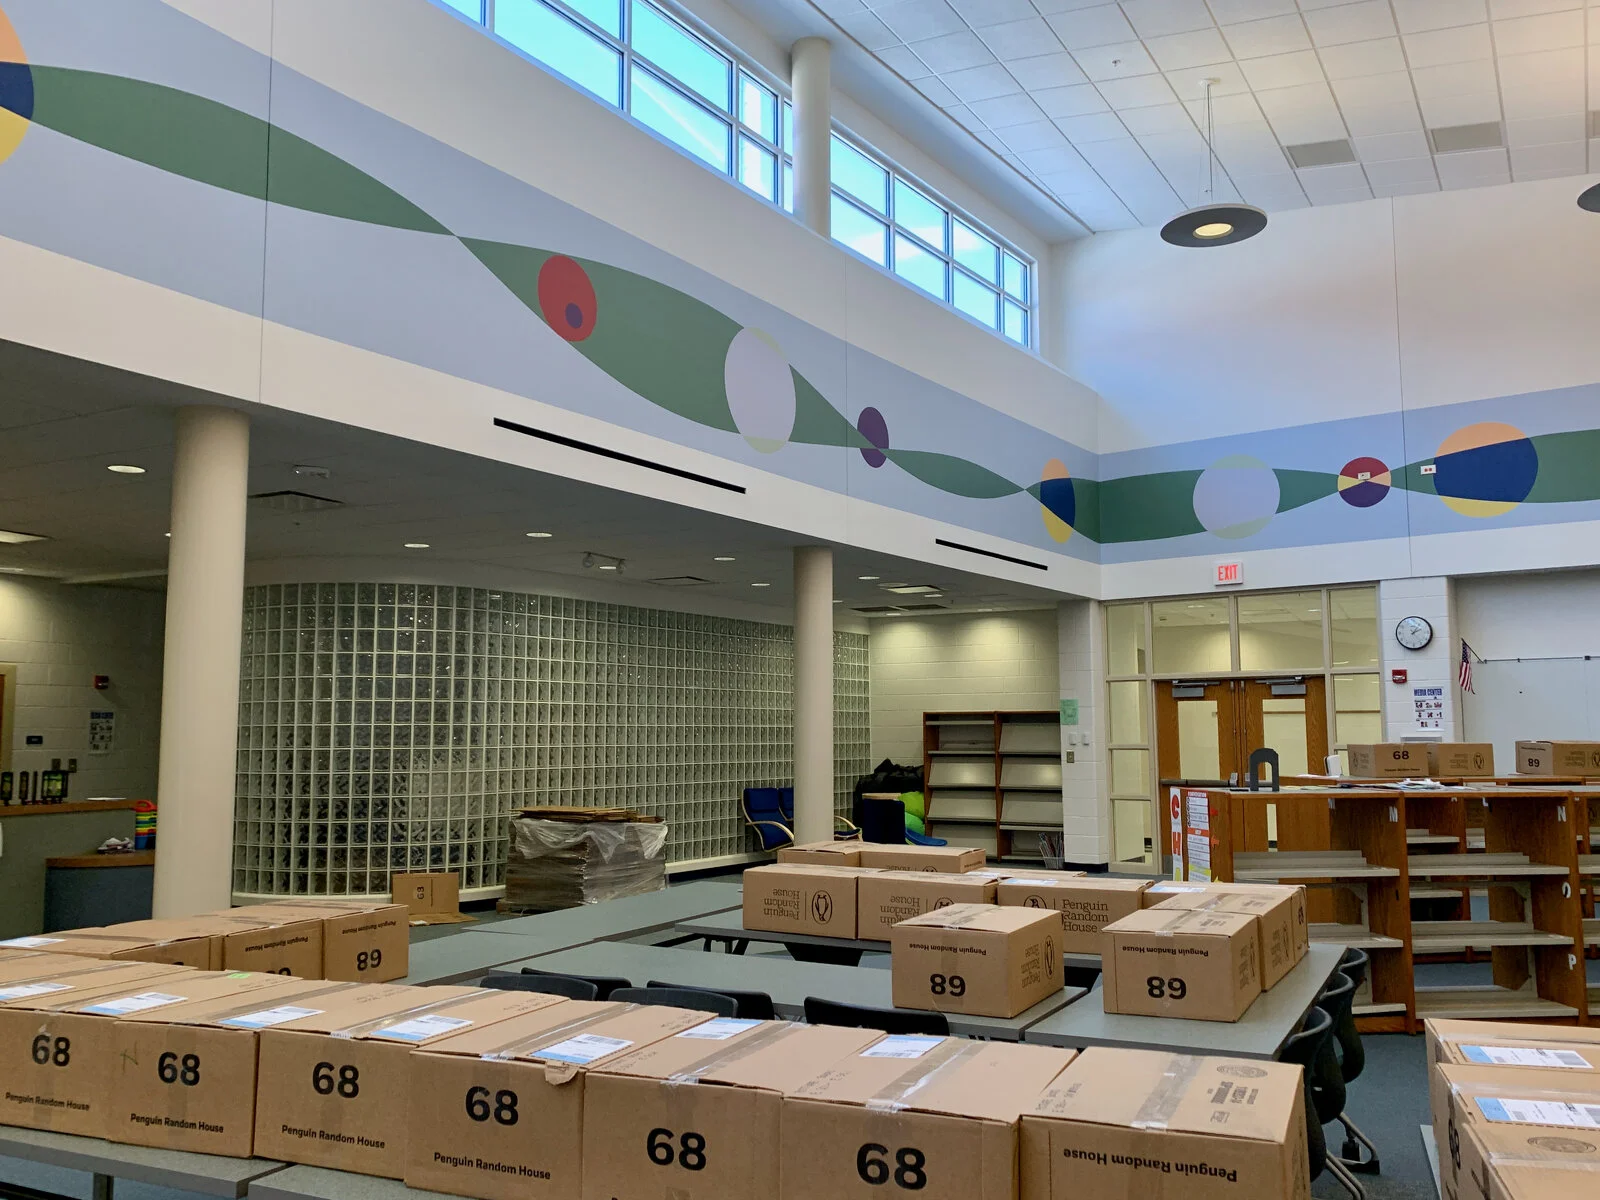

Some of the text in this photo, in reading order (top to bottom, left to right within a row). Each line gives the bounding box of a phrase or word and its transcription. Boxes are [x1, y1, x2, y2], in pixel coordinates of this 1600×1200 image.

[1218, 564, 1238, 581] EXIT
[1393, 750, 1410, 760] 68
[1528, 758, 1540, 768] 68
[1172, 794, 1180, 819] C
[1389, 806, 1398, 822] M
[1557, 805, 1567, 822] N
[1173, 832, 1181, 856] H
[764, 898, 800, 909] Random
[773, 888, 800, 900] House
[890, 895, 920, 906] House
[763, 907, 800, 920] Penguin
[1061, 899, 1109, 913] Penguin
[1062, 910, 1110, 923] Random
[1062, 921, 1098, 933] House
[909, 943, 987, 956] Penguin Random House
[1122, 945, 1209, 957] Penguin Random House
[357, 949, 382, 971] 68
[1567, 953, 1577, 970] P
[929, 973, 966, 997] 68
[1146, 976, 1187, 1000] 68
[31, 1034, 71, 1067] 68
[157, 1052, 200, 1086] 68
[312, 1061, 359, 1098] 68
[5, 1091, 90, 1111] Penguin Random House
[465, 1086, 519, 1126] 68
[130, 1113, 224, 1133] Penguin Random House
[281, 1124, 386, 1149] Penguin Random House
[646, 1127, 707, 1171] 68
[434, 1152, 551, 1180] Penguin Random House
[856, 1142, 927, 1190] 68
[1063, 1148, 1238, 1182] Penguin Random House
